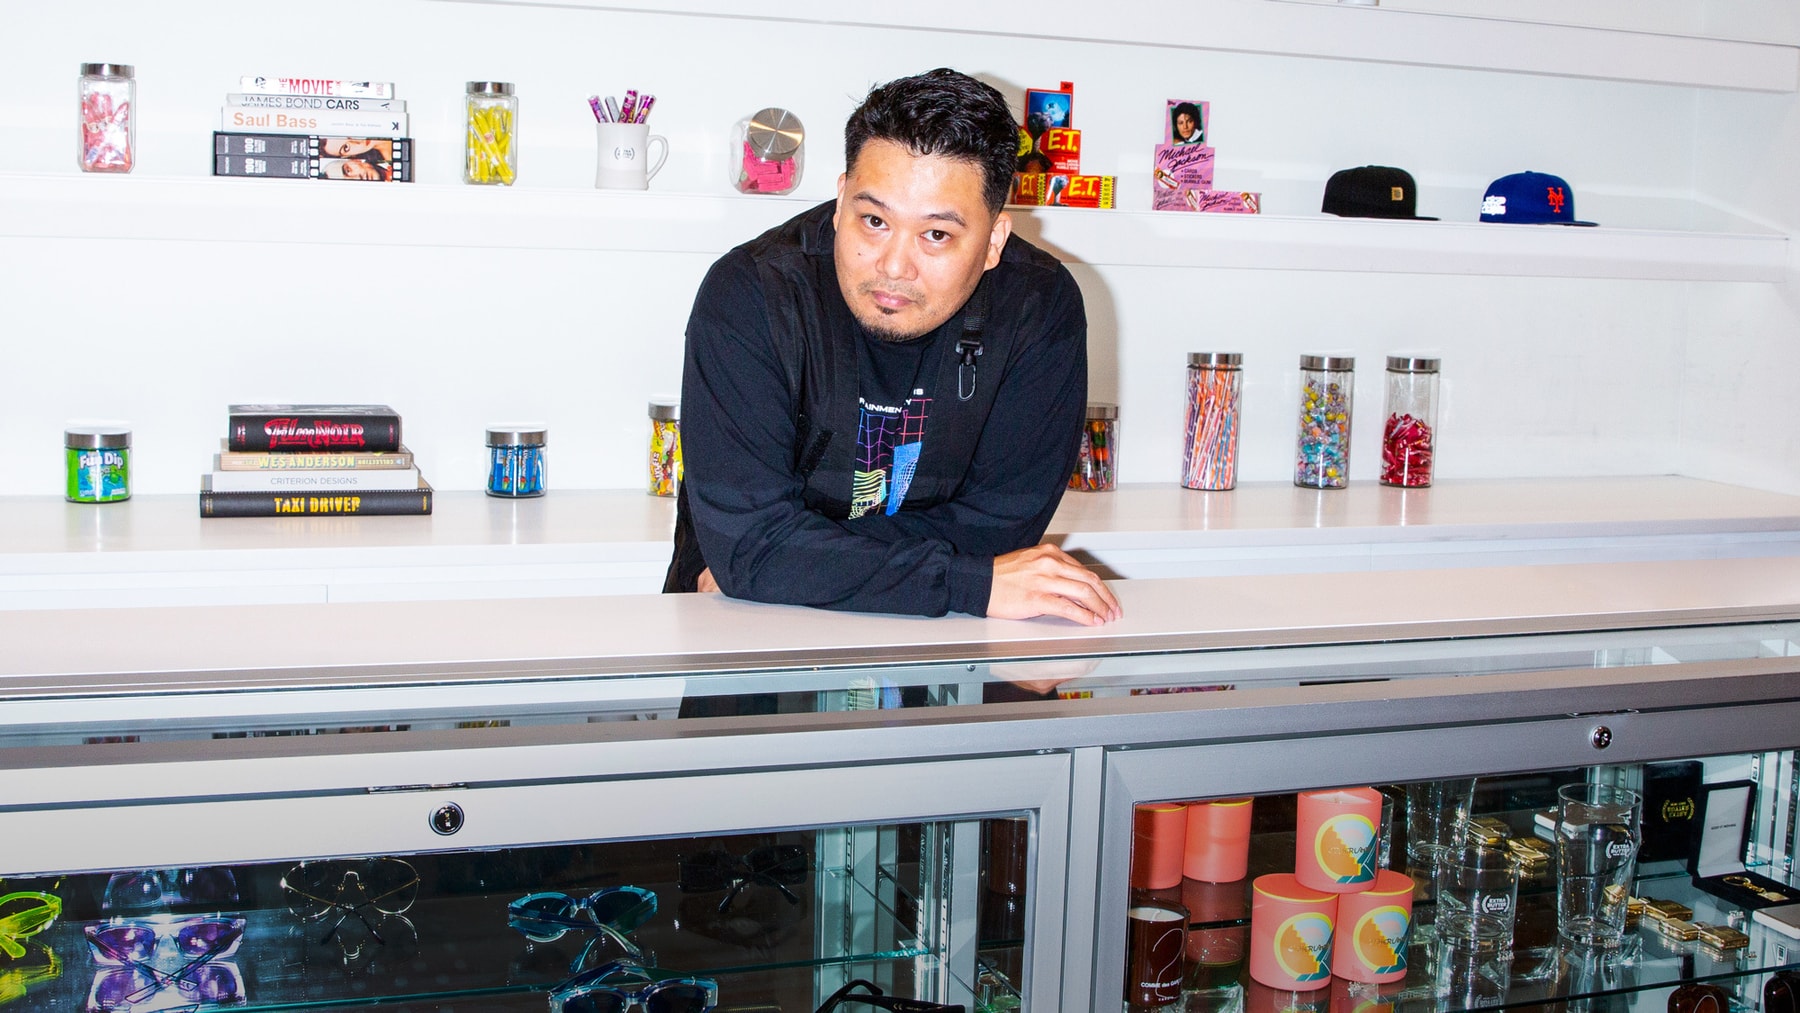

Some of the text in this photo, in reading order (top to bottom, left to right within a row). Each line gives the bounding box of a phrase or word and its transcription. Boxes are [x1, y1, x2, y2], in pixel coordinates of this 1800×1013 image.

[289, 79, 333, 95] MOVIE
[241, 96, 360, 110] JAMES BOND CARS
[233, 112, 270, 127] Saul
[277, 114, 317, 129] Bass
[244, 138, 254, 154] 100
[1048, 129, 1081, 152] E.T.
[1158, 143, 1204, 164] Michael
[245, 158, 254, 174] 100
[1167, 153, 1214, 174] Jackson
[1068, 176, 1100, 197] E.T.
[80, 452, 124, 470] Fun Dip
[258, 456, 287, 469] WES
[289, 456, 356, 469] ANDERSON
[271, 477, 358, 486] CRITERION DESIGNS
[274, 497, 361, 513] TAXI DRIVER
